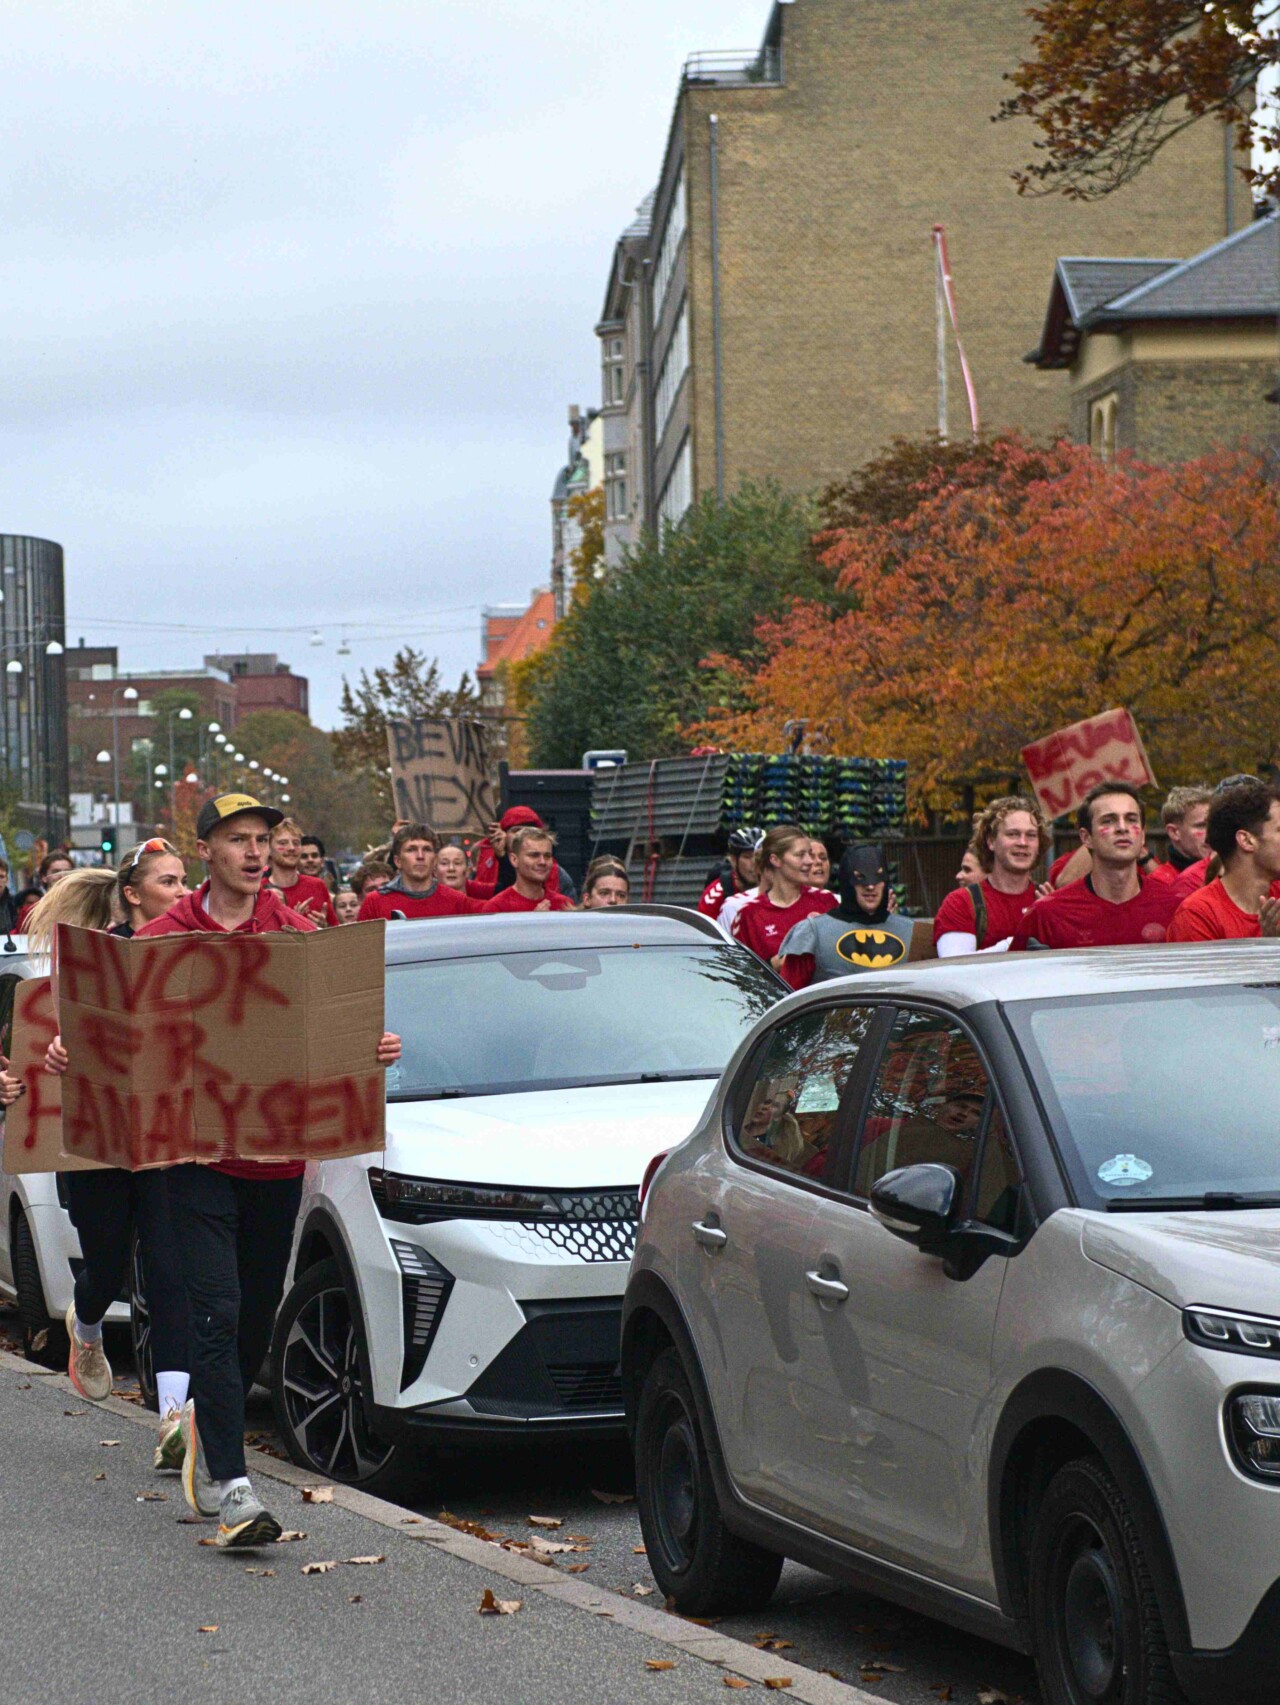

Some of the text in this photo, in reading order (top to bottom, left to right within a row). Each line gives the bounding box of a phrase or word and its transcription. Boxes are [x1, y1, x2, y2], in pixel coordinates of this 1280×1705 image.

[58, 924, 291, 1025] HVOR
[78, 1014, 233, 1084] ER
[69, 1073, 380, 1166] ANALYSEN
